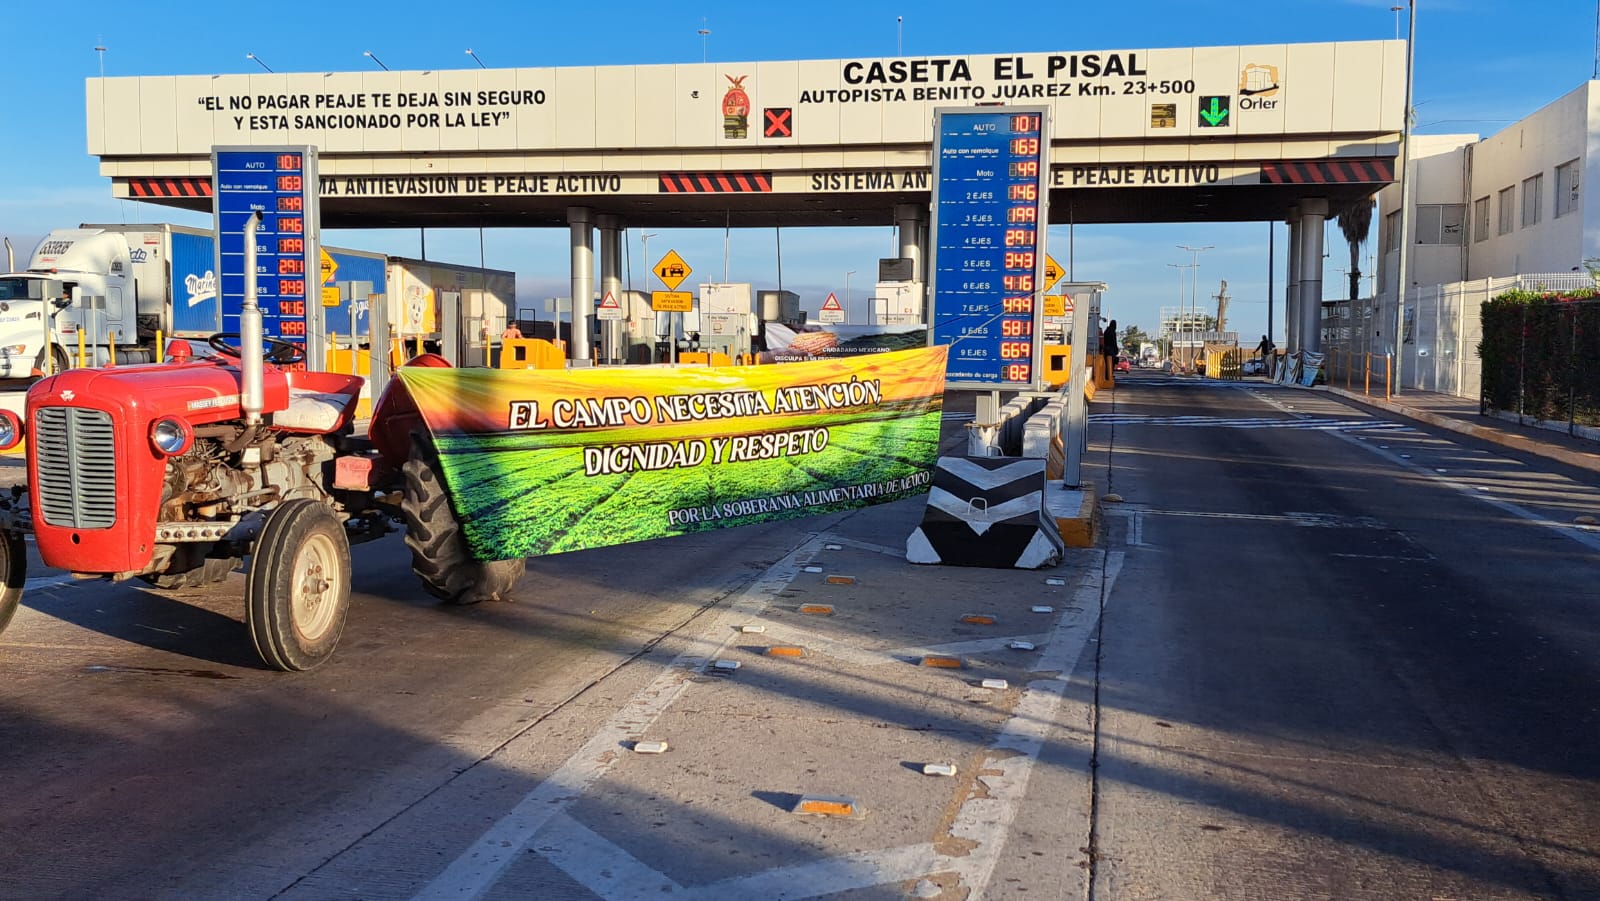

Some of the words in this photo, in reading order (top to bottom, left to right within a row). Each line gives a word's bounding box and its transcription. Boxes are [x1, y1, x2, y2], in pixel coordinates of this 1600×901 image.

[843, 59, 972, 84] CASETA
[994, 57, 1034, 80] EL
[1048, 53, 1146, 78] PISAL
[800, 88, 906, 103] AUTOPISTA
[913, 86, 985, 101] BENITO
[992, 83, 1071, 98] JUAREZ
[1078, 82, 1116, 96] Km.
[1123, 80, 1195, 95] 23+500
[229, 96, 252, 110] NO
[257, 94, 310, 109] PAGAR
[315, 93, 366, 108] PEAJE
[371, 93, 391, 107] TE
[397, 92, 439, 107] DEJA
[444, 91, 471, 106] SIN
[477, 90, 546, 106] SEGURO
[1239, 97, 1278, 110] Orler
[234, 116, 244, 130] Y
[250, 115, 289, 130] ESTA
[294, 114, 401, 129] SANCIONADO
[407, 113, 440, 128] POR
[445, 113, 466, 127] LA
[973, 123, 996, 131] AUTO
[1015, 116, 1039, 132] 101
[1014, 139, 1038, 155] 163
[281, 155, 301, 170] 101
[1018, 162, 1037, 177] 49
[811, 171, 895, 190] SISTEMA
[1050, 167, 1064, 185] E
[1072, 166, 1136, 184] PEAJE
[1143, 164, 1219, 184] ACTIVO
[281, 176, 302, 190] 163
[319, 177, 338, 194] MA
[345, 176, 458, 194] ANTIEVASION
[465, 176, 487, 193] DE
[494, 175, 549, 193] PEAJE
[555, 174, 621, 193] ACTIVO
[1012, 184, 1036, 200] 146
[285, 197, 302, 210] 49
[1011, 207, 1035, 222] 199
[282, 218, 302, 232] 146
[283, 238, 303, 253] 199
[1005, 230, 1034, 246] 291
[279, 259, 303, 274] 291
[1005, 252, 1033, 268] 343
[280, 280, 304, 295] 343
[1003, 276, 1032, 291] 416
[280, 301, 304, 316] 416
[1002, 298, 1031, 313] 499
[280, 321, 305, 335] 499
[1002, 320, 1031, 335] 581
[1001, 342, 1030, 358] 669
[1009, 365, 1028, 380] 82
[509, 401, 547, 430] EL
[553, 396, 652, 428] CAMPO
[655, 391, 771, 422] NECESITA
[774, 376, 882, 413] ATENCIÓN,
[584, 440, 706, 476] DIGNIDAD
[711, 438, 728, 464] Y
[729, 428, 829, 462] RESPETO
[668, 507, 700, 525] POR
[702, 505, 721, 521] LA
[803, 483, 884, 507] ALIMENTARIA
[885, 480, 898, 494] DE
